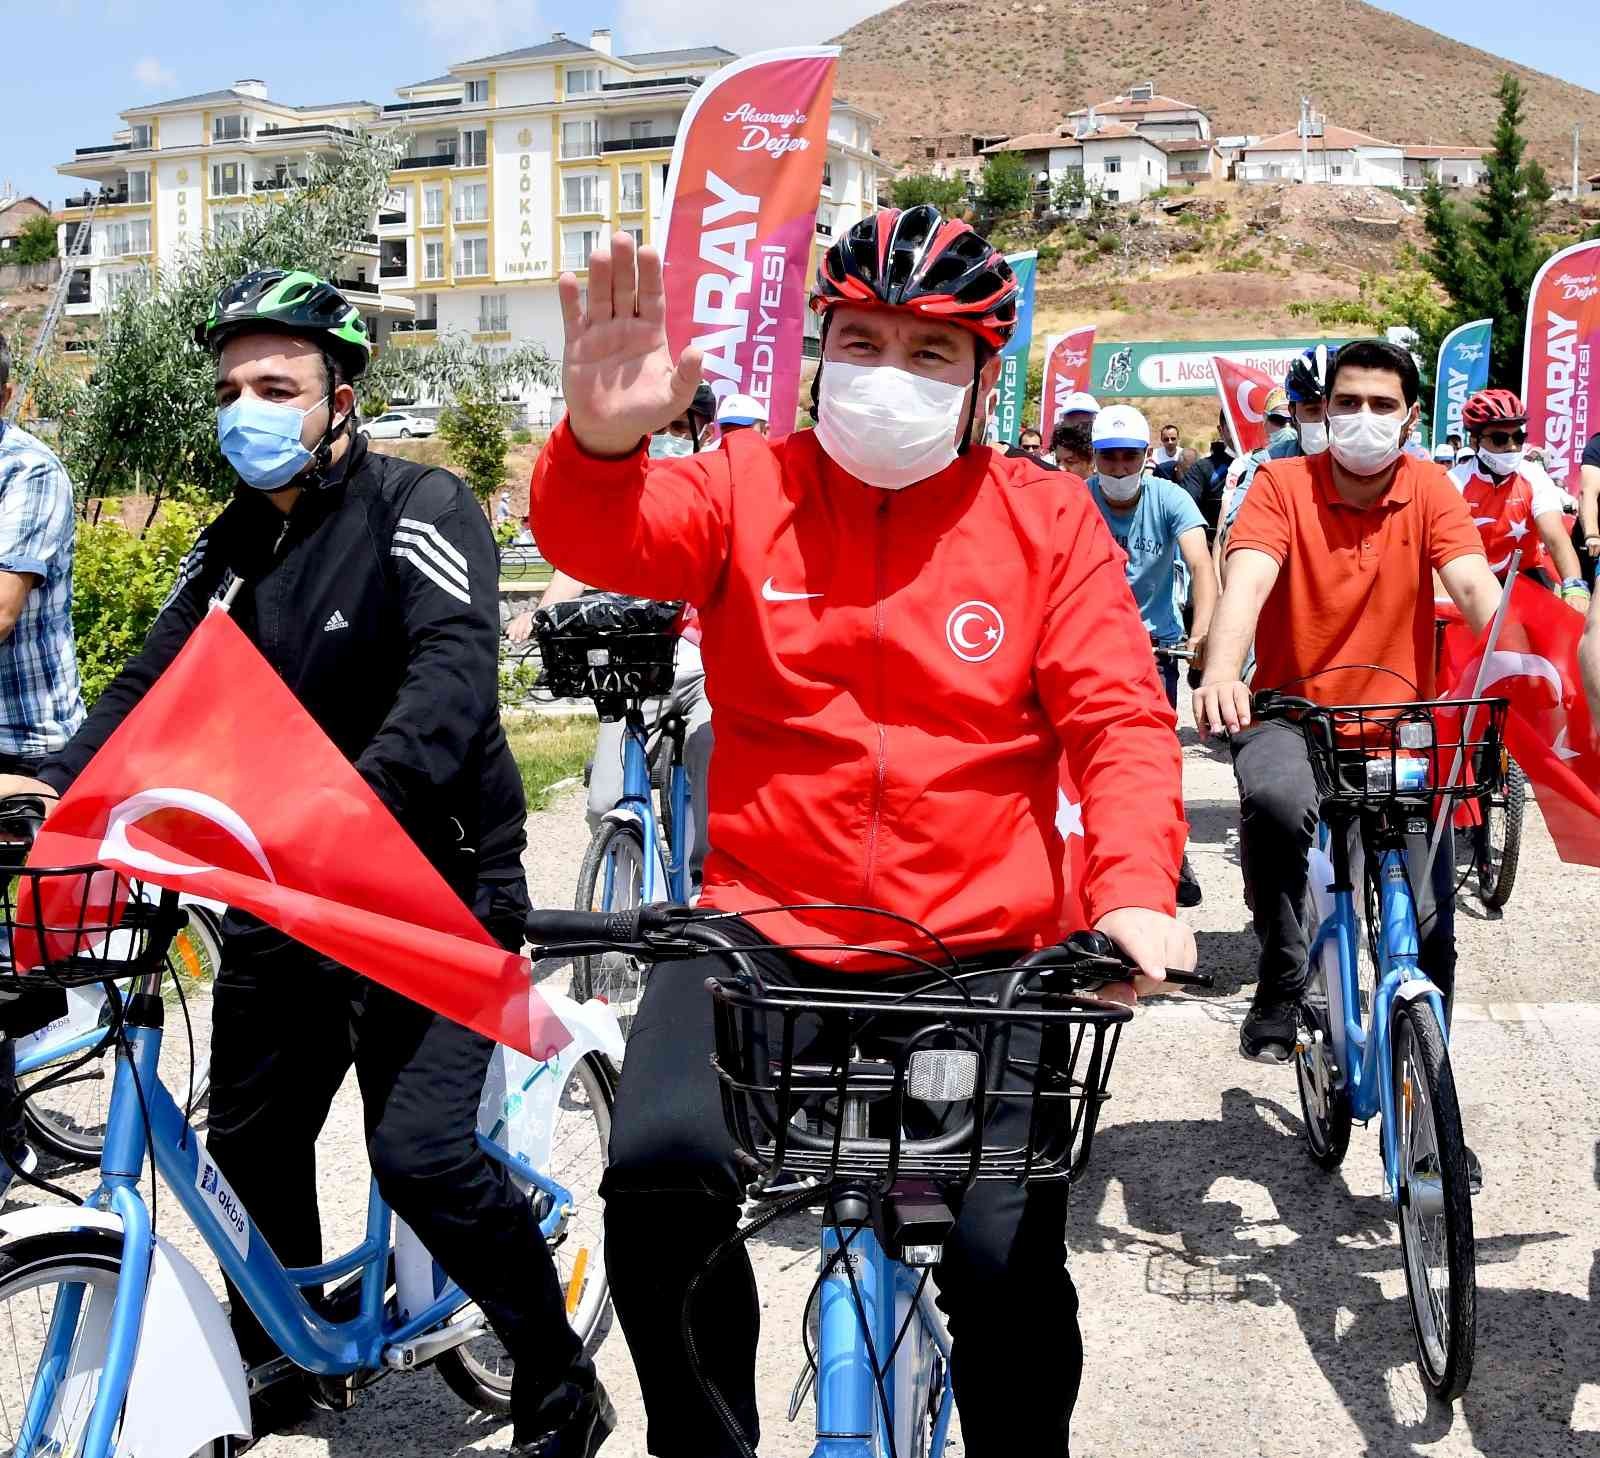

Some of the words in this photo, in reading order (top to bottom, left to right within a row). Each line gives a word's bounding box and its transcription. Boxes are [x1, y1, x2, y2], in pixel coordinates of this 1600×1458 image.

[736, 124, 810, 159] Değer
[176, 190, 188, 246] GÖK
[518, 153, 532, 258] GÖKAY
[1002, 355, 1017, 444] LEDİYESİ
[1154, 361, 1171, 383] 1.
[1178, 361, 1216, 380] Aksa
[1447, 367, 1469, 447] ARAY
[218, 1191, 245, 1233] akbis
